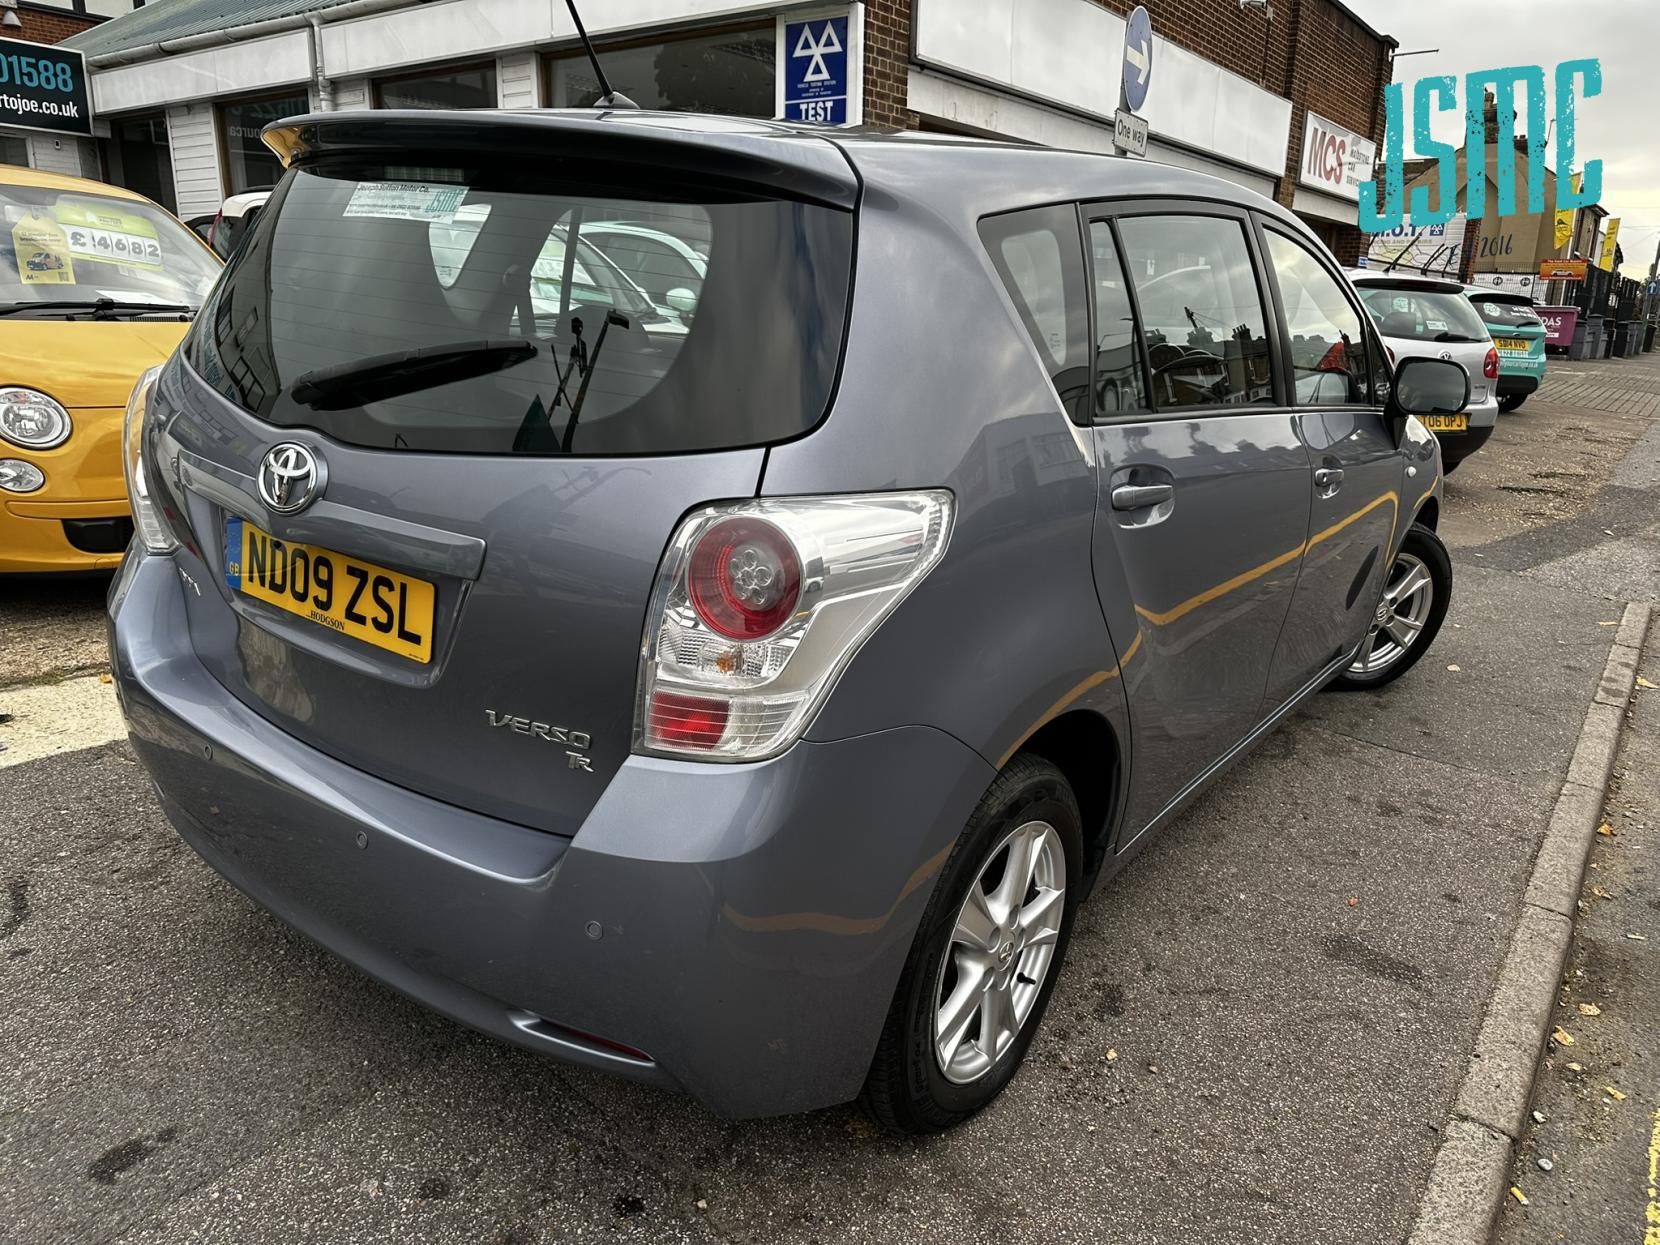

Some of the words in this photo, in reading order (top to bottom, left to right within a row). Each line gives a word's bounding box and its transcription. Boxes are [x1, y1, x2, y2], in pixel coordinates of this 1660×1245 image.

[800, 100, 834, 121] TEST
[1117, 118, 1130, 139] One
[1307, 126, 1346, 184] MCS
[1480, 234, 1513, 258] 2016
[229, 561, 240, 576] GB
[248, 531, 334, 612] ND09
[344, 564, 421, 646] ZSL
[310, 610, 345, 631] HODGSON
[485, 709, 591, 750] VERSO
